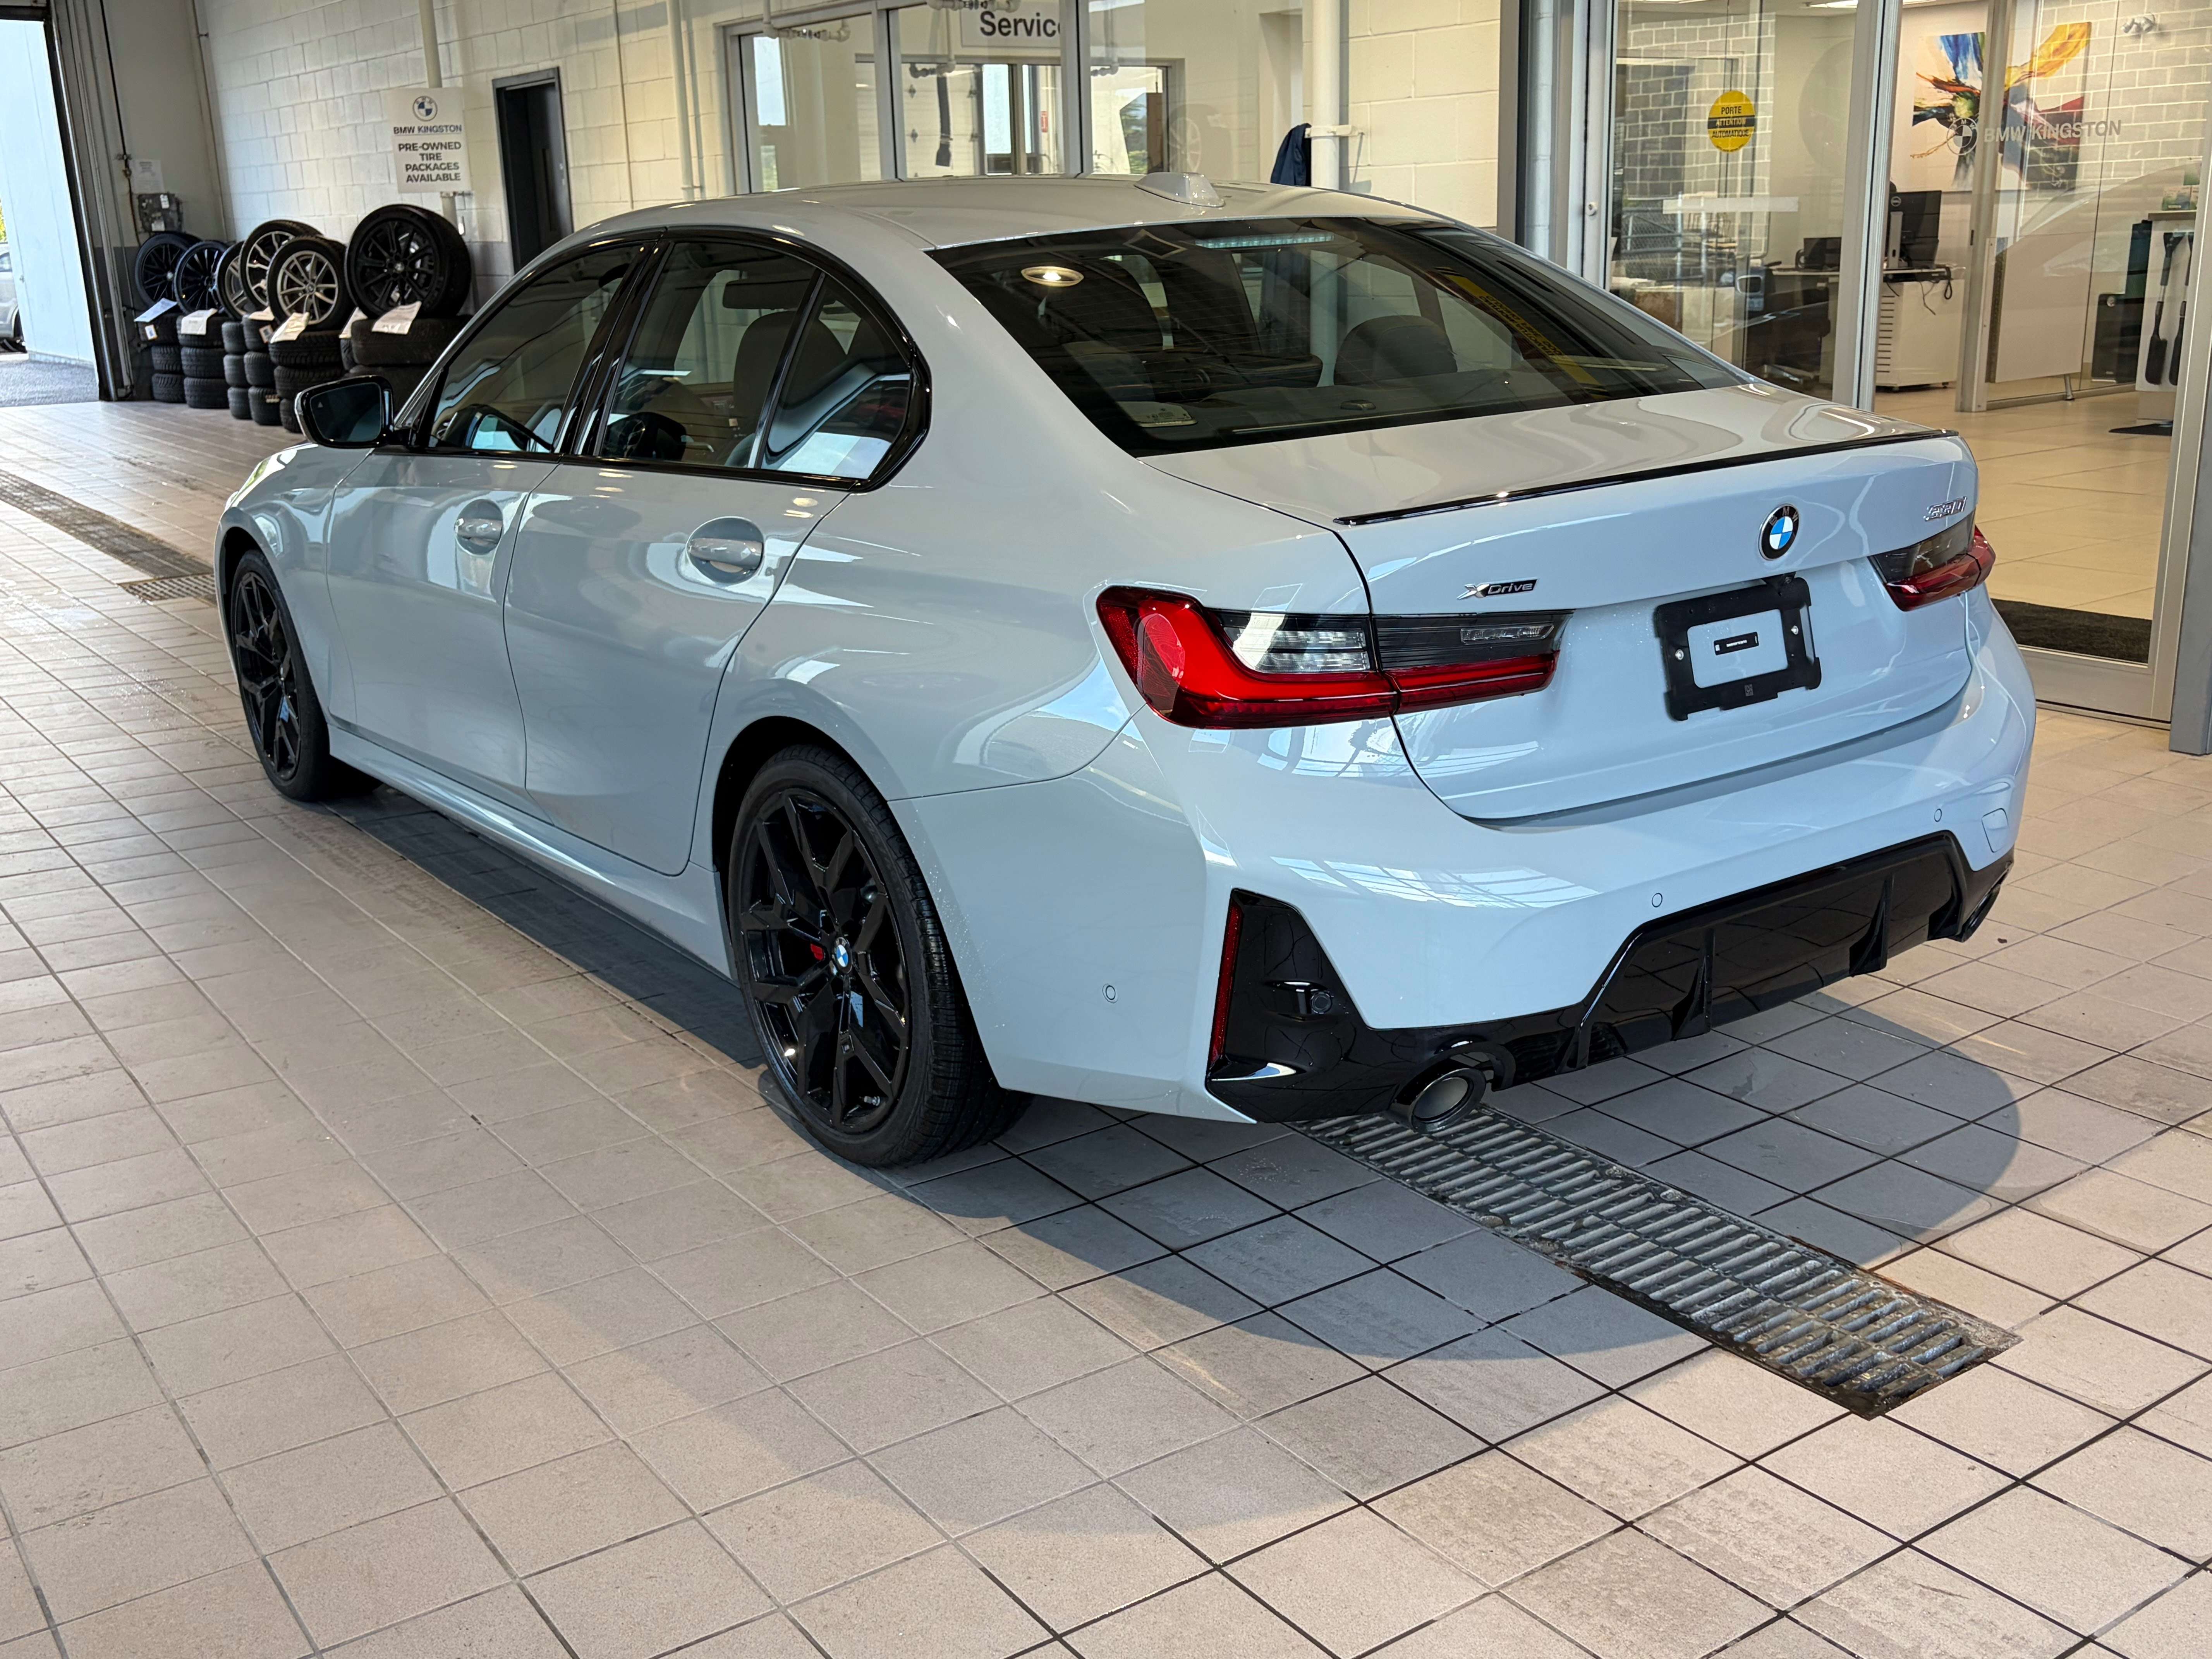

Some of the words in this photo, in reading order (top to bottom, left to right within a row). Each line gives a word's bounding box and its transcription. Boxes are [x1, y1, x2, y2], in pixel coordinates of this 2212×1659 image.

[980, 11, 1060, 37] Servic
[1721, 106, 1741, 114] PORTE
[1716, 118, 1746, 126] ATTENTION
[417, 125, 462, 133] KINGSTON
[1712, 129, 1749, 138] AUTOMATIQUE
[1984, 125, 2026, 143] BMW
[2032, 120, 2121, 140] KINGSTON
[398, 141, 462, 151] PRE-OWNED
[419, 153, 442, 161] TIRE
[405, 162, 459, 172] PACKAGES
[406, 173, 461, 183] AVAILABLE
